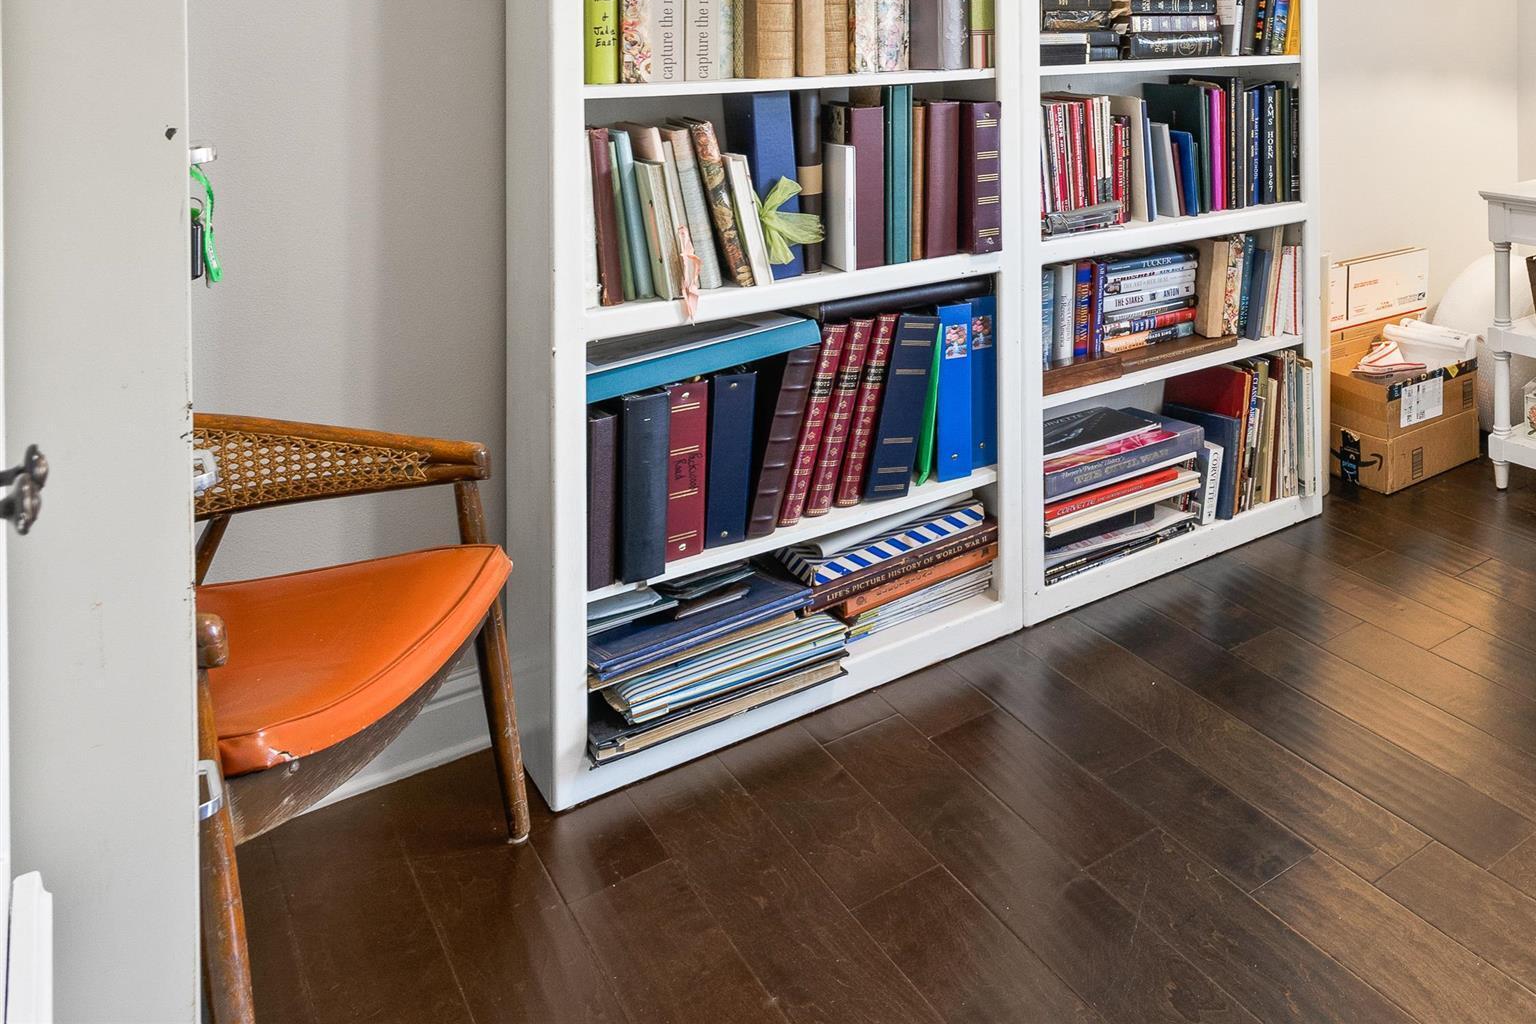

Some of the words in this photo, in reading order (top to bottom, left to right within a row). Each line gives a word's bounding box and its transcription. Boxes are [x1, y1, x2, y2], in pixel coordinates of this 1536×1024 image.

[658, 8, 673, 28] the
[694, 8, 709, 28] the
[661, 32, 677, 80] capture
[696, 32, 713, 79] capture
[1142, 256, 1173, 268] TUCKER
[1080, 283, 1089, 302] TOM
[1115, 298, 1125, 308] THE
[1125, 295, 1144, 306] STAKES
[1163, 288, 1180, 298] ANTON
[1079, 304, 1089, 341] BROKAW
[1250, 377, 1259, 405] CLASSIC
[1207, 451, 1219, 505] CORVETTE
[1057, 498, 1096, 516] CORVETTE
[826, 587, 850, 602] LIFE'S
[852, 575, 886, 592] PICTURE
[887, 560, 922, 579] HISTORY
[923, 555, 934, 566] OF
[935, 545, 963, 563] WORLD
[964, 539, 981, 549] WAR
